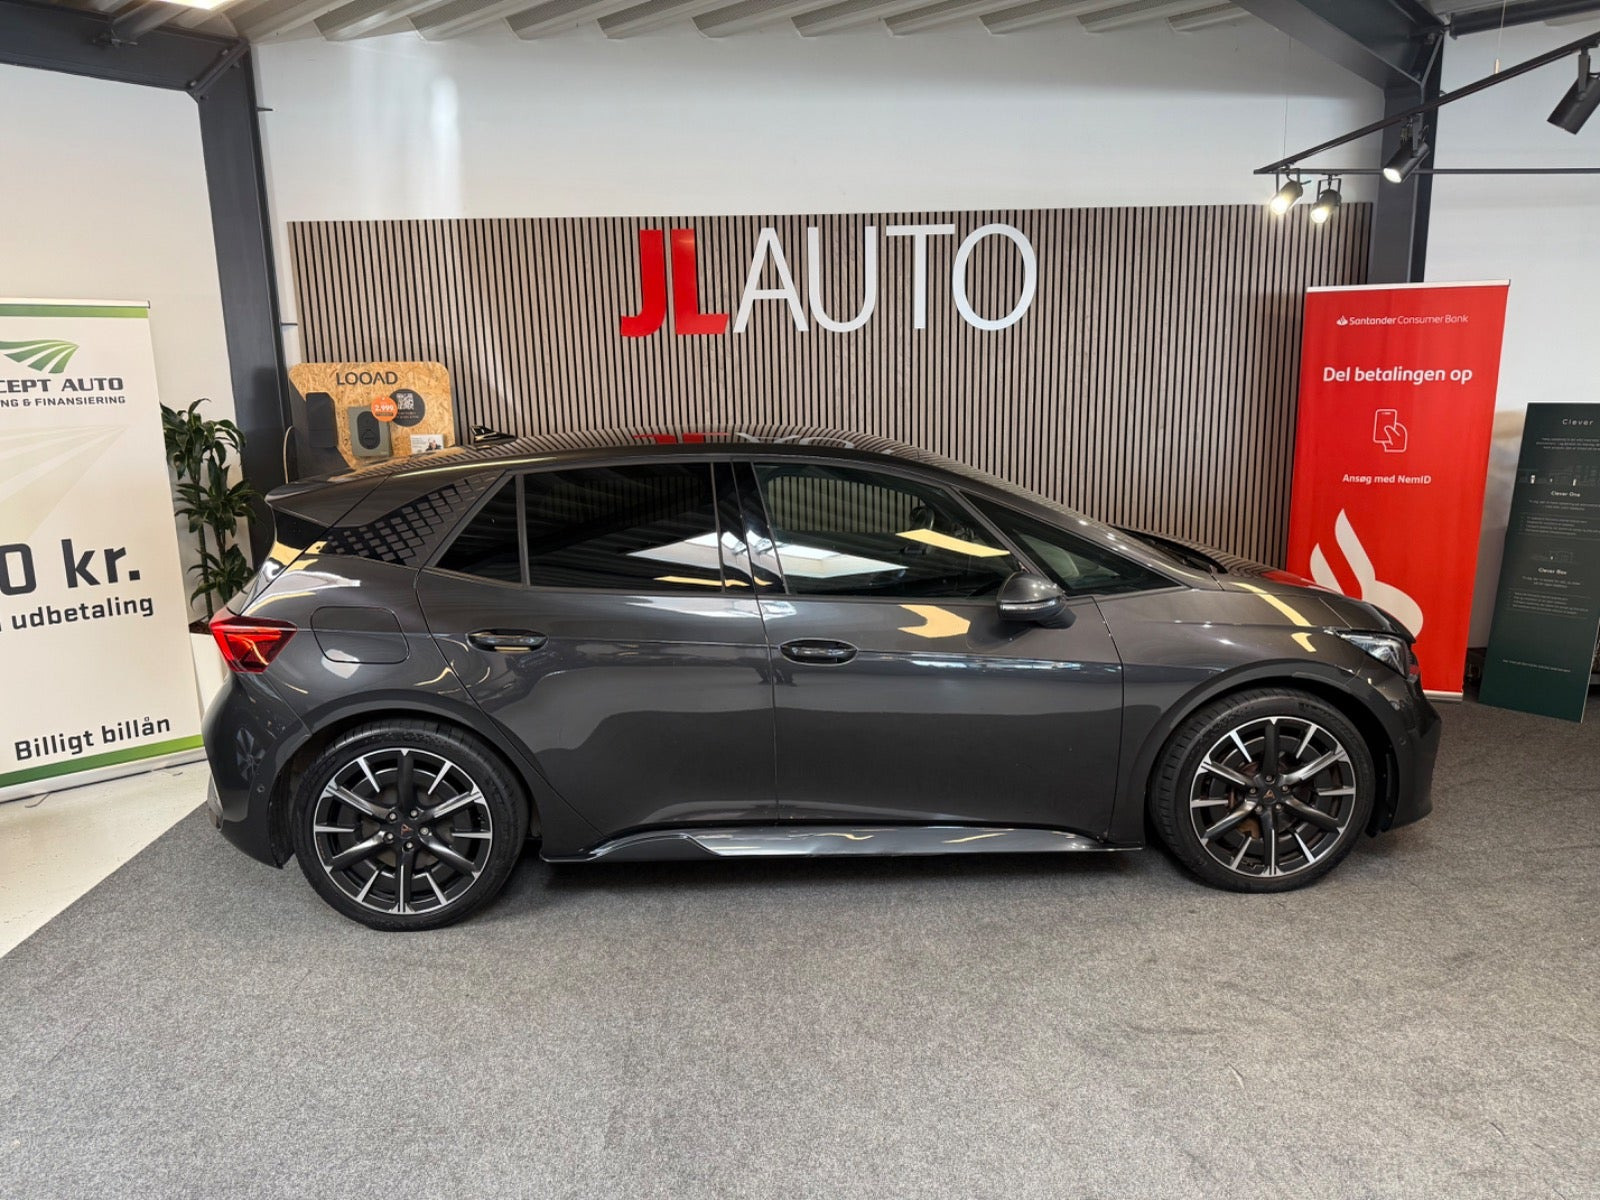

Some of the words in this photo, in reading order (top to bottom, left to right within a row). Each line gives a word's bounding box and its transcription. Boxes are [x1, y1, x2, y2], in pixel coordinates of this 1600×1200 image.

[1349, 315, 1396, 326] Santander
[1397, 315, 1444, 325] Consumer
[1445, 314, 1469, 324] Bank
[1323, 366, 1350, 382] Del
[1354, 366, 1446, 385] betalingen
[1449, 368, 1473, 385] op
[61, 377, 124, 392] AUTO
[23, 398, 31, 407] &
[35, 395, 126, 407] FINANSIERING
[1342, 473, 1372, 485] Ansøg
[1374, 474, 1396, 483] med
[1397, 475, 1432, 484] NemID
[0, 543, 37, 596] 0
[61, 538, 141, 589] kr.
[11, 596, 154, 630] udbetaling
[14, 730, 95, 762] Billigt
[101, 716, 171, 745] billån
